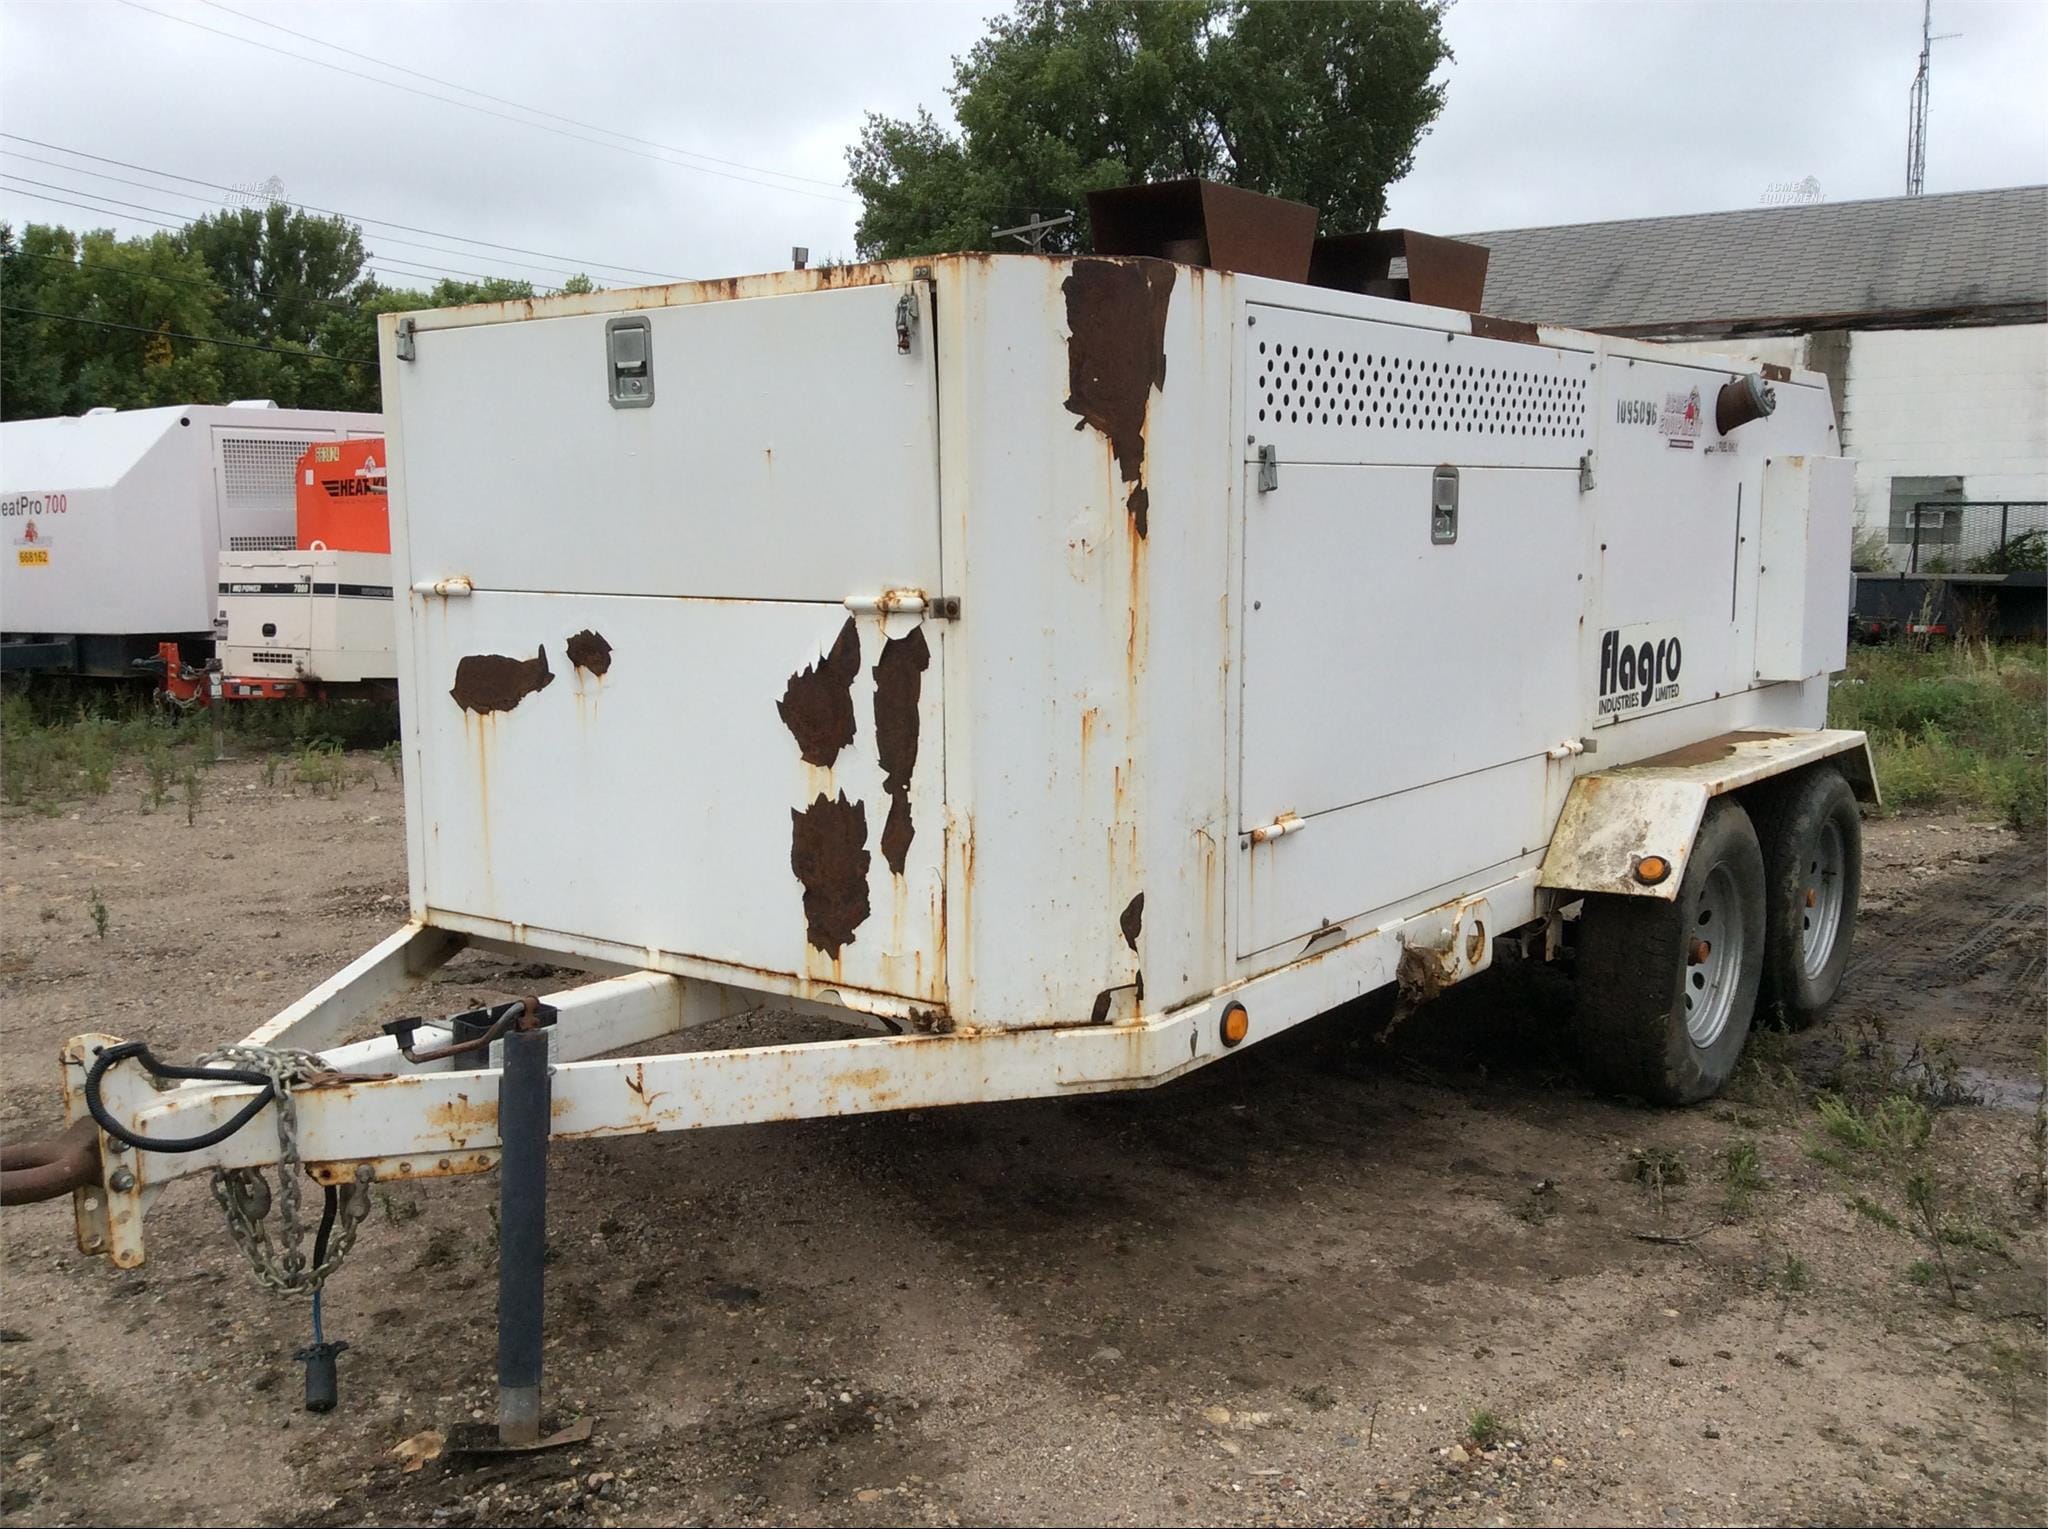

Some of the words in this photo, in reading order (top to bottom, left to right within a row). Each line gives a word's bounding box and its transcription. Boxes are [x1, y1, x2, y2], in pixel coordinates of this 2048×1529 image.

[340, 478, 369, 496] HEAT
[0, 496, 42, 517] eatPro
[44, 494, 67, 514] 700
[1600, 630, 1681, 707] flagro
[1599, 691, 1640, 715] INDUSTRIES
[1655, 683, 1680, 702] LIMITED
